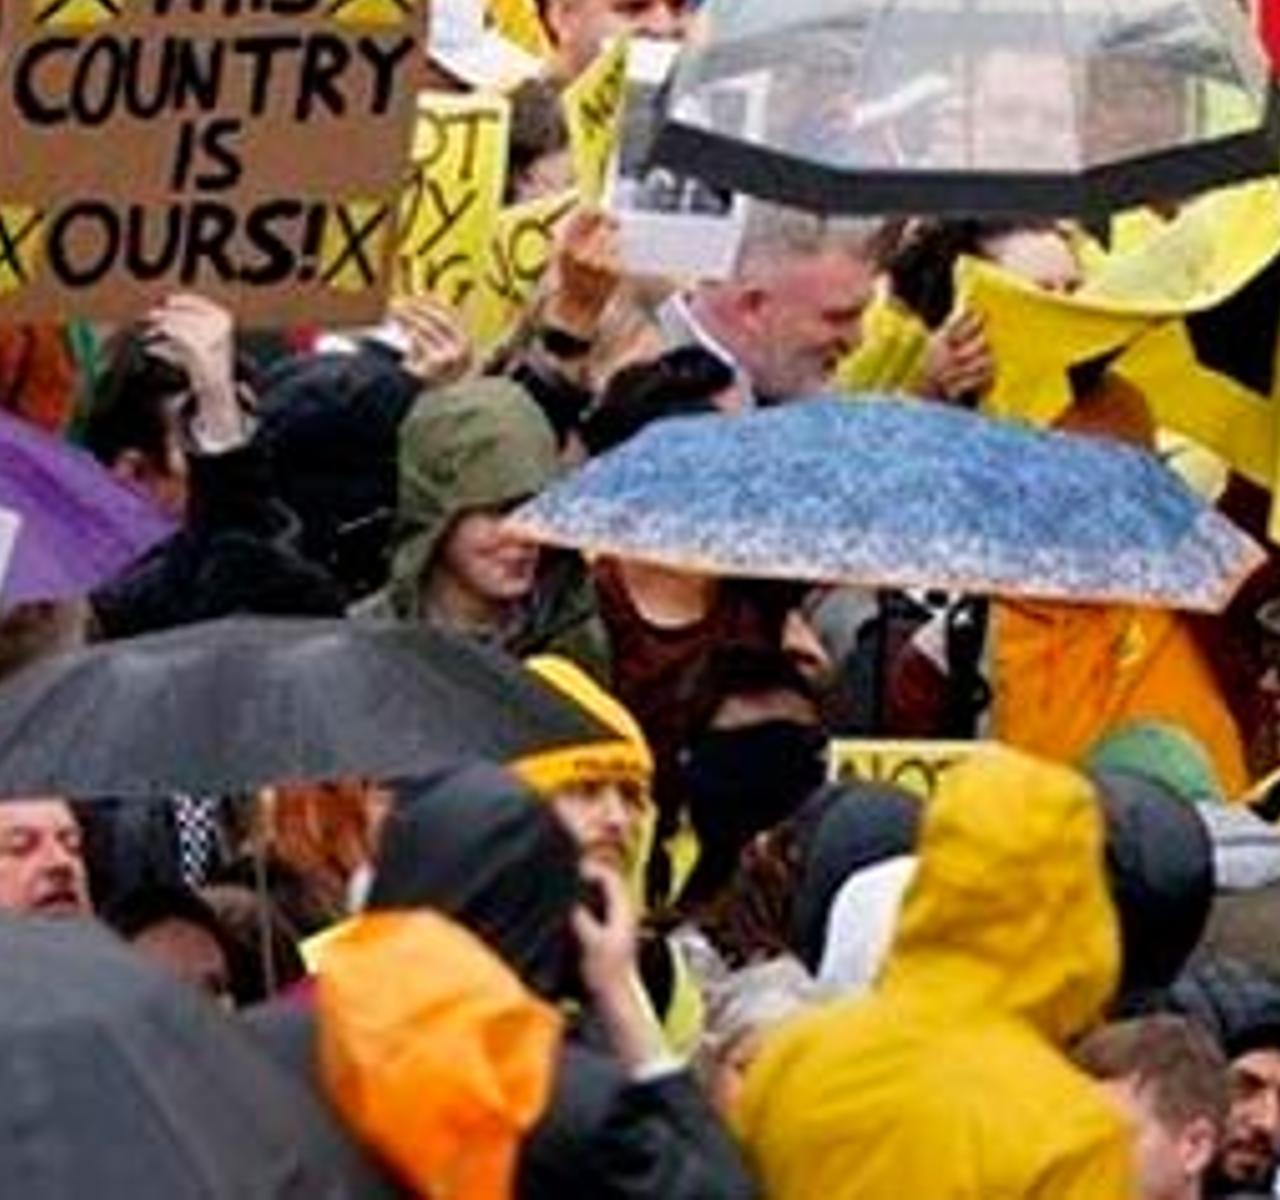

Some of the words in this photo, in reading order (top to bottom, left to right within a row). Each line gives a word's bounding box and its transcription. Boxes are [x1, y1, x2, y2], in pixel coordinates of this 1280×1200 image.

[14, 35, 415, 127] COUNTRY
[173, 118, 244, 193] IS
[48, 197, 326, 287] OURS!
